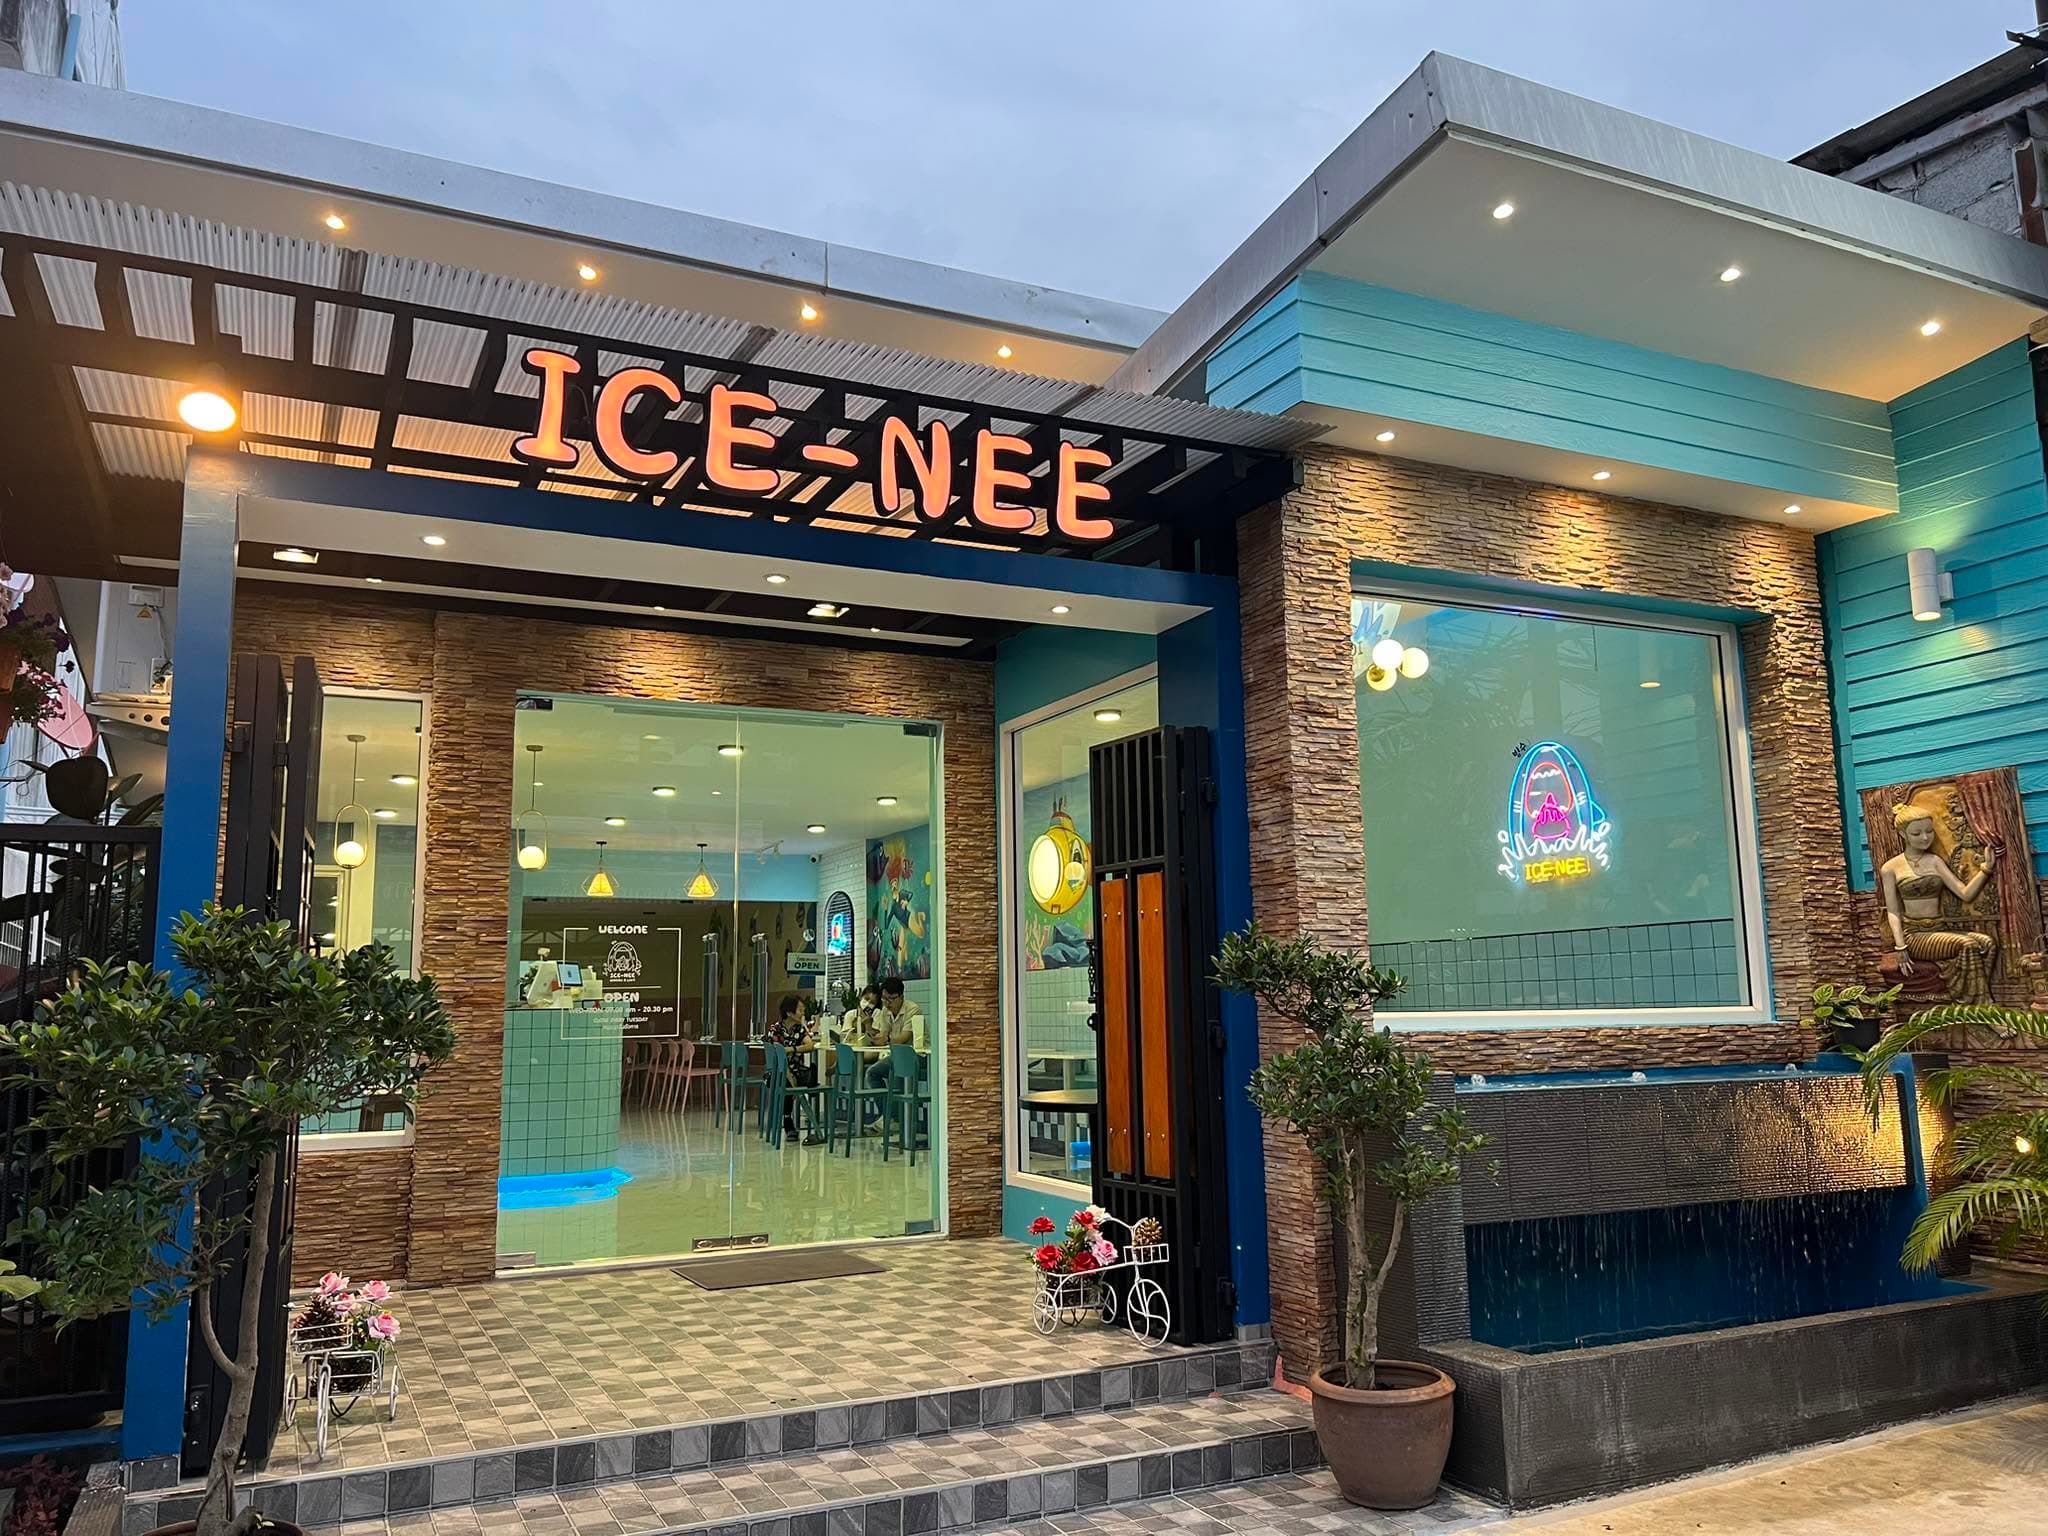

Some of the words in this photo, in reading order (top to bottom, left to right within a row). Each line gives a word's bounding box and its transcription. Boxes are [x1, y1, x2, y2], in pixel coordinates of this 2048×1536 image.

[514, 349, 1115, 540] ICE-NEE
[1511, 742, 1527, 758] 빙수
[598, 925, 649, 935] WELCOME
[794, 961, 820, 970] OPEN
[603, 991, 640, 1003] OPEN
[662, 1006, 674, 1014] pm
